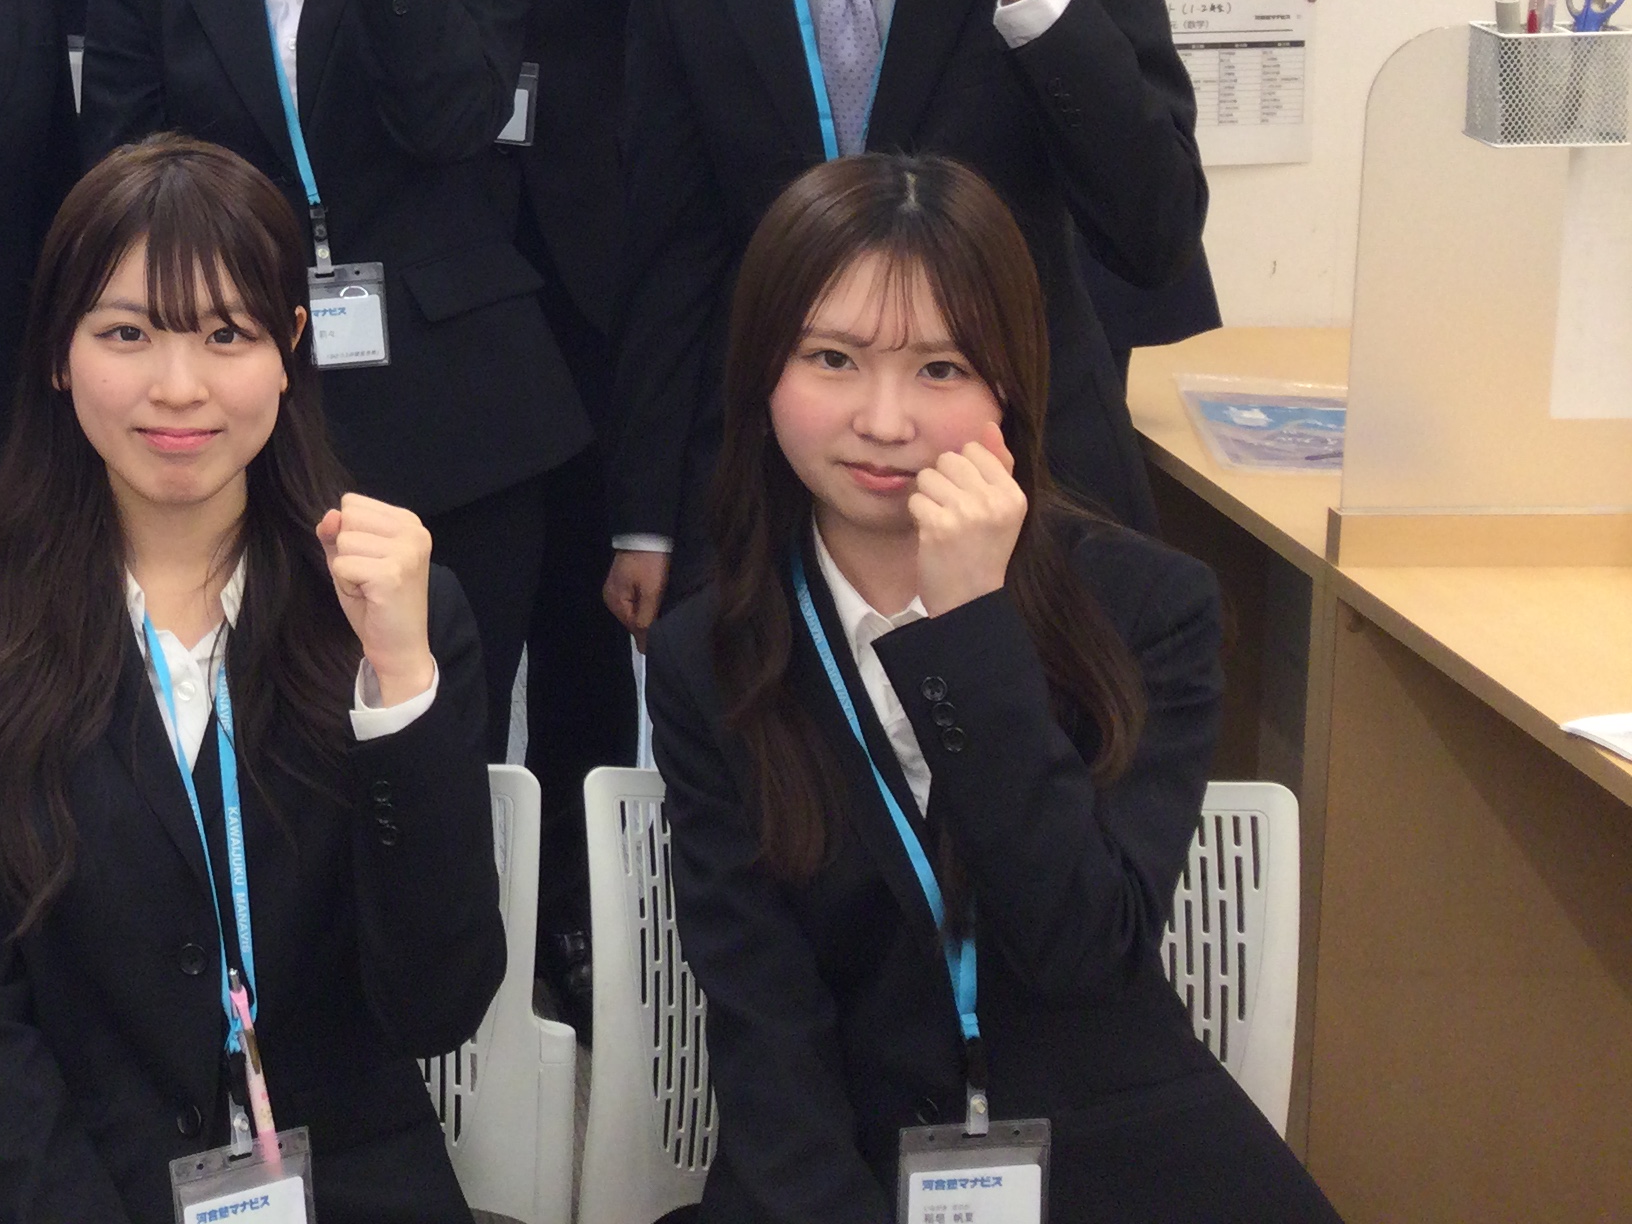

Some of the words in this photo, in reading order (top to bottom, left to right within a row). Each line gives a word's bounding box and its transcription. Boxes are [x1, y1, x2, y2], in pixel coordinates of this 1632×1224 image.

[227, 805, 246, 887] KAWAIJUKU
[235, 891, 251, 954] MANAVIS
[922, 1176, 1003, 1191] 河合塾マナビス
[196, 1195, 271, 1224] 河合塾マナビス
